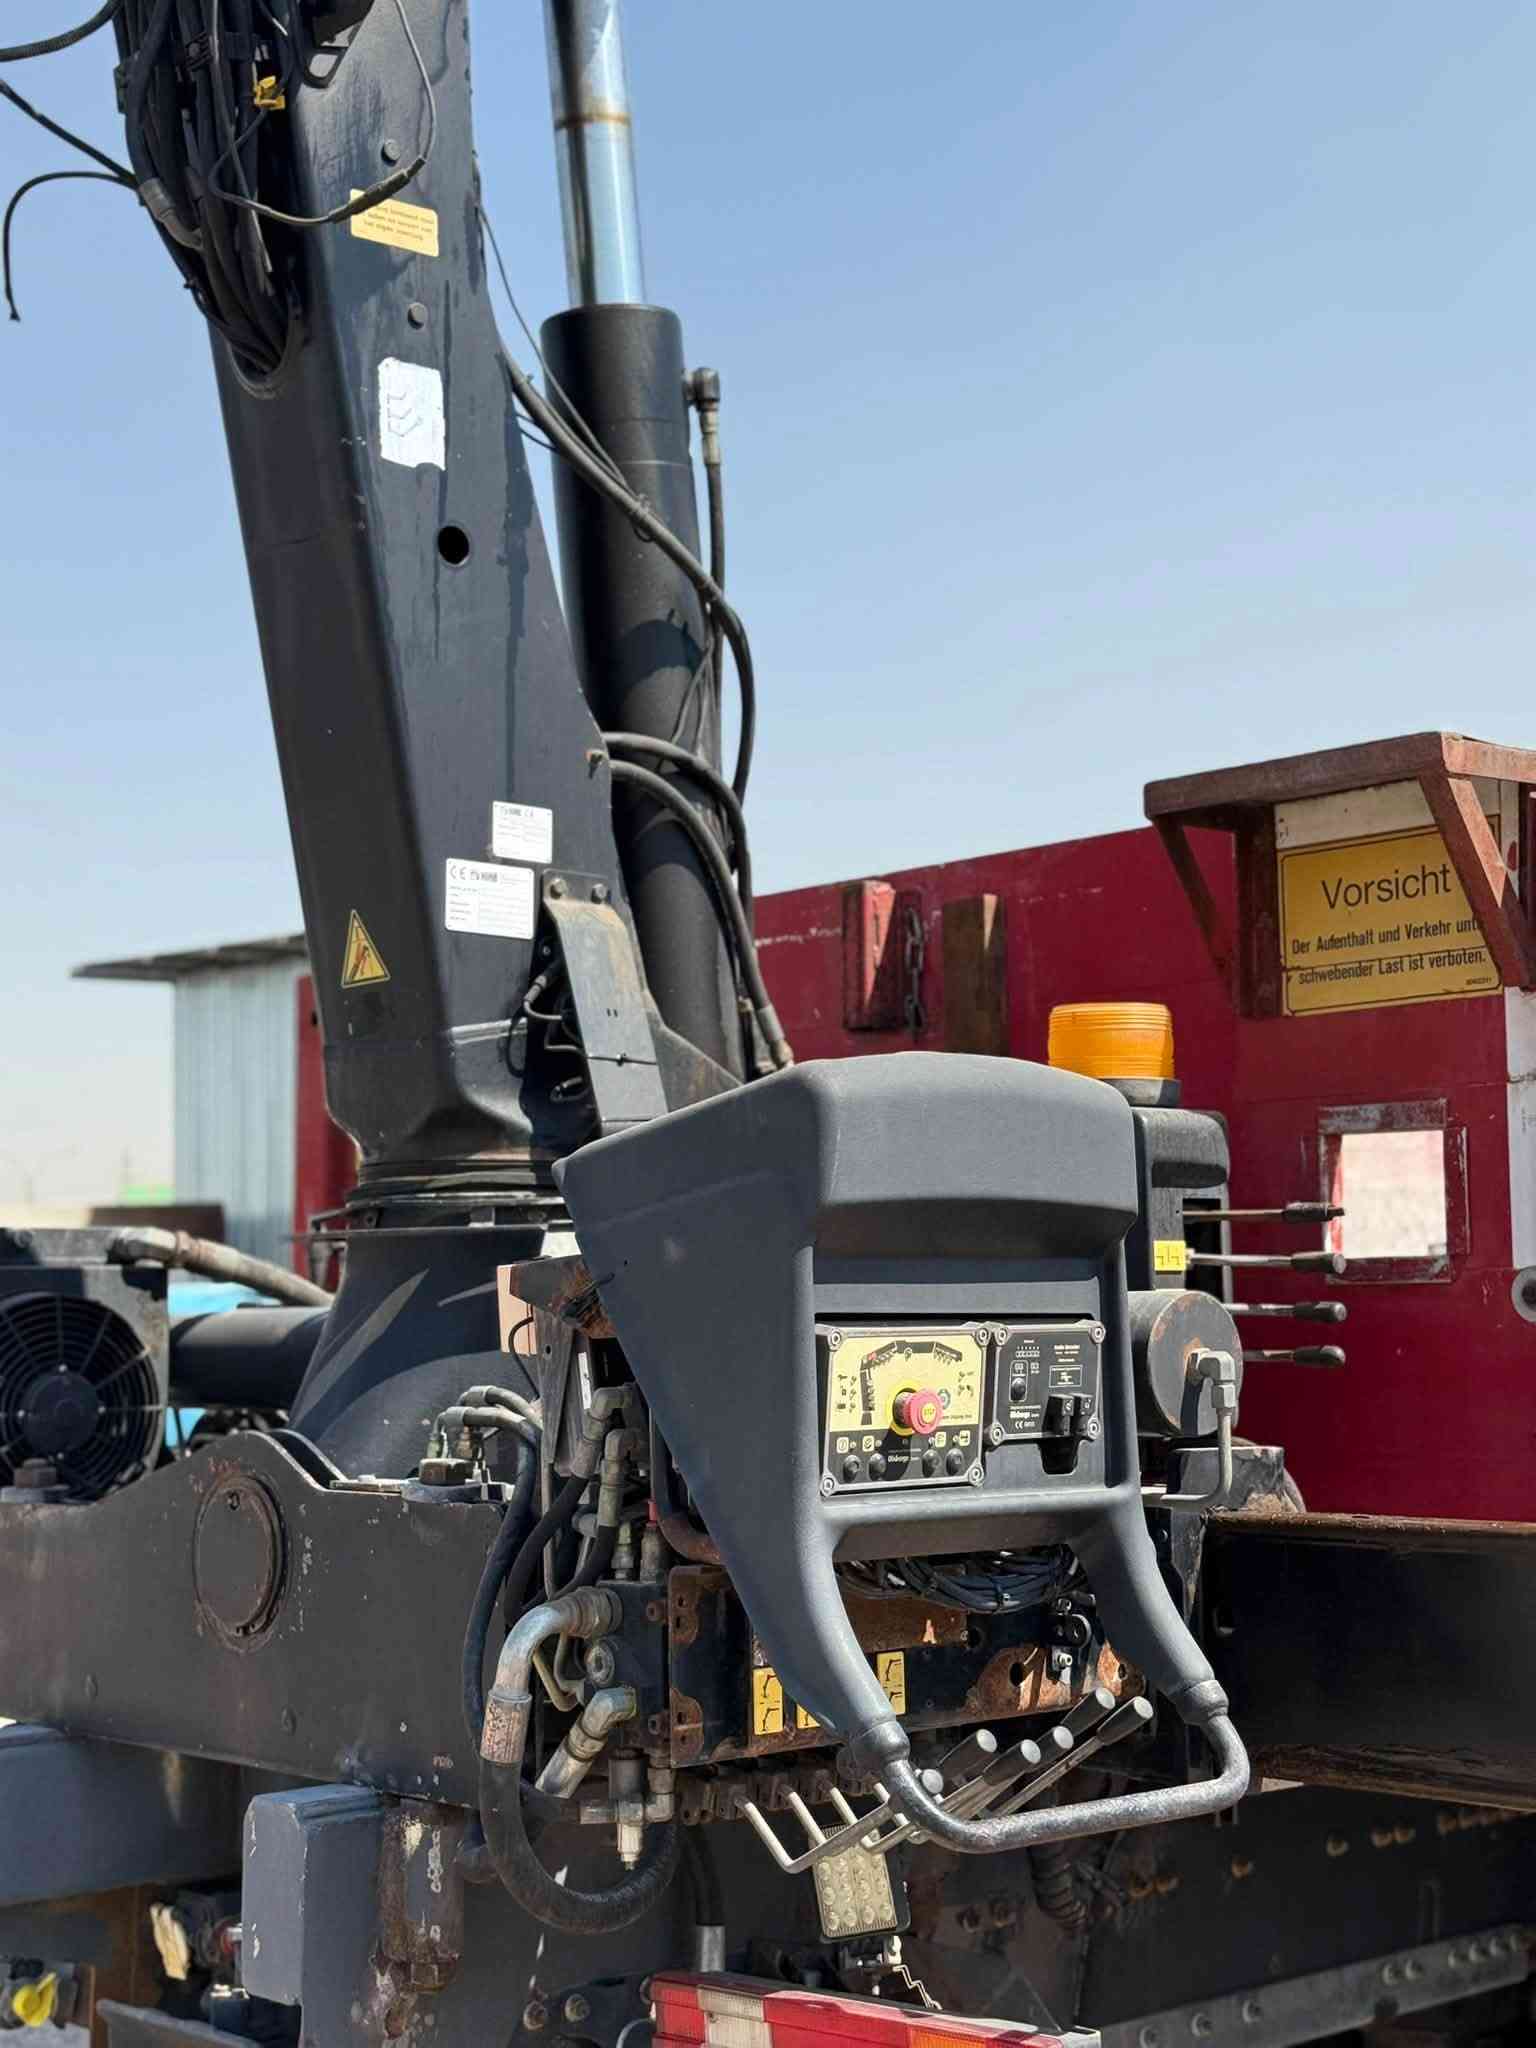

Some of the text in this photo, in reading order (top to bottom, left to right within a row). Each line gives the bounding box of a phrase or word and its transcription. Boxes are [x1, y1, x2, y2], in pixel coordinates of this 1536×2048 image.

[1321, 863, 1452, 909] Vorsicht
[1292, 918, 1483, 954] Der Aufenthalt und Verkehr unt
[1299, 948, 1487, 985] schwebender Last ist verboten.
